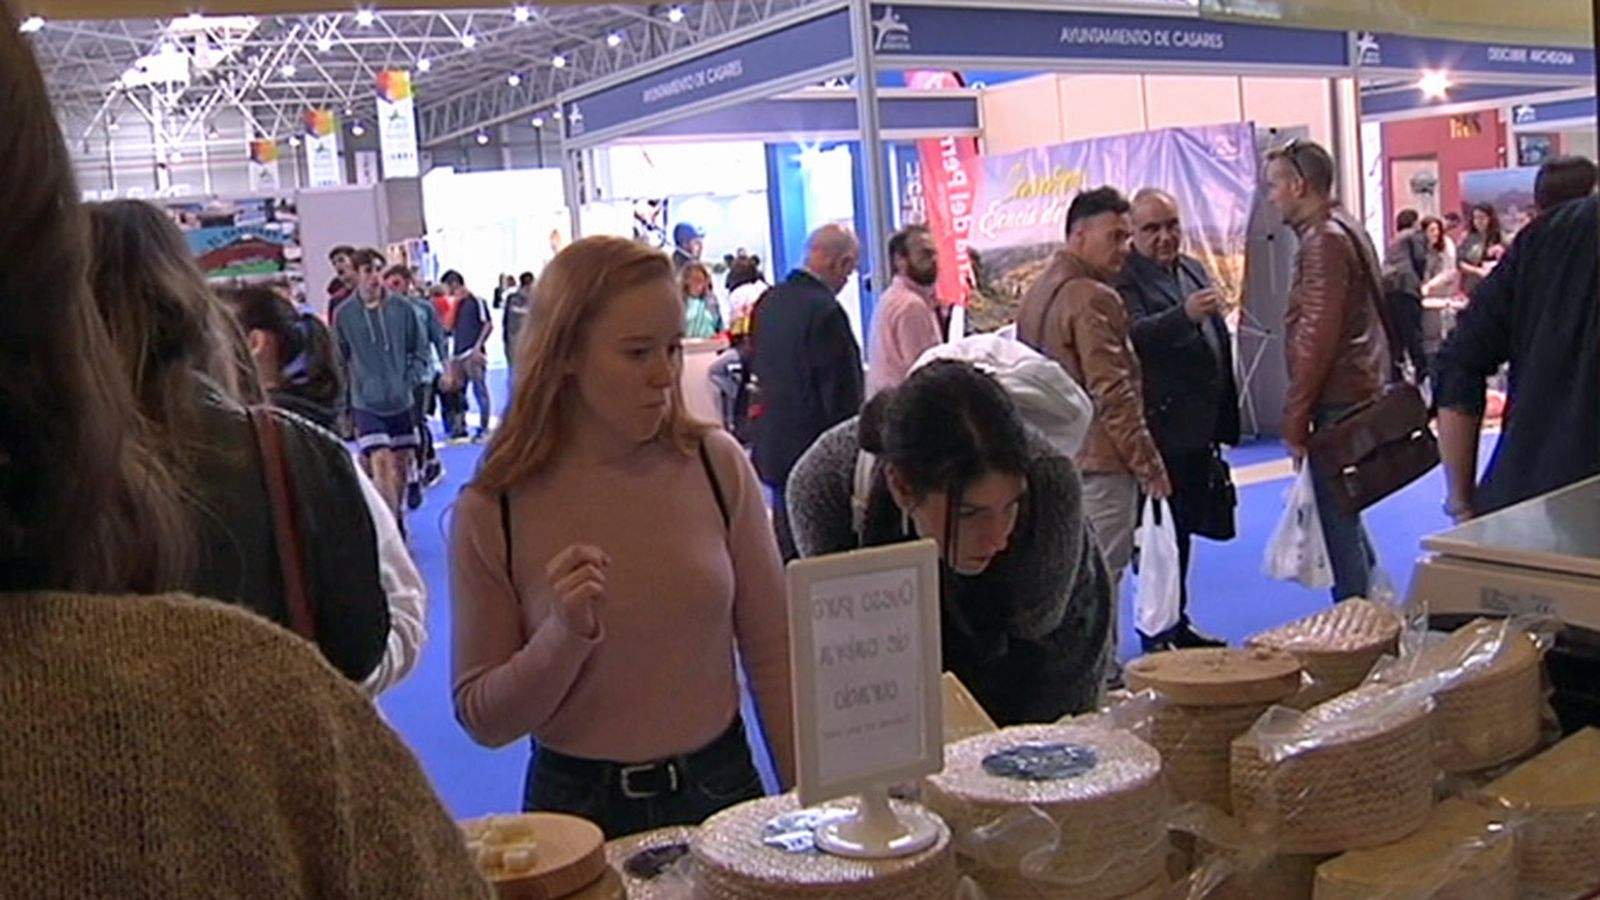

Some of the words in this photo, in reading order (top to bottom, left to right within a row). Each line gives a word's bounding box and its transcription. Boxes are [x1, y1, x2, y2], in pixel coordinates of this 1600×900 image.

[1060, 26, 1152, 46] AYUNTAMIENTO
[1154, 30, 1170, 46] DE
[1172, 31, 1224, 49] CASARES
